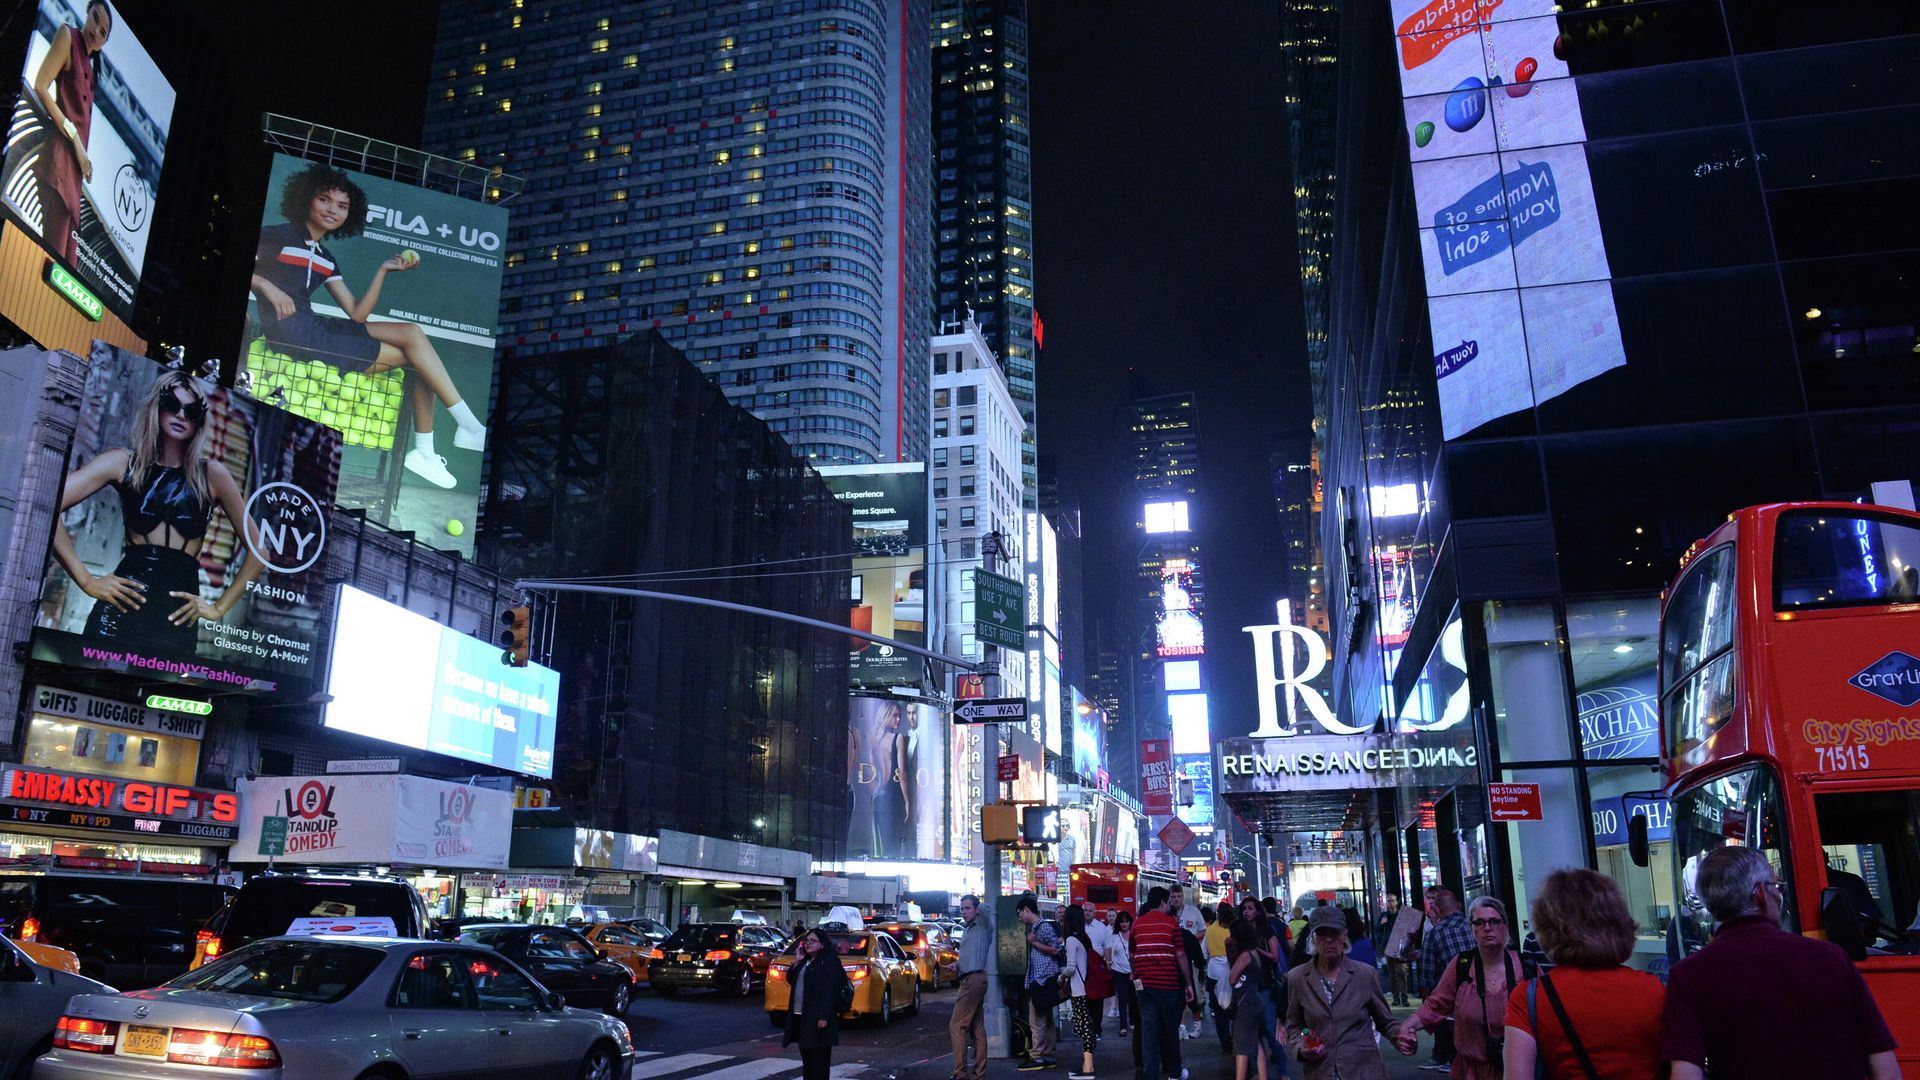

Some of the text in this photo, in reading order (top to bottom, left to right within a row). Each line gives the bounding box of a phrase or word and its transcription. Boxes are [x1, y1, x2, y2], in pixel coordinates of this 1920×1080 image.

[118, 187, 142, 225] NY
[365, 204, 430, 236] FILA
[459, 225, 500, 251] UO
[72, 230, 94, 257] Clothing
[111, 226, 135, 254] FASHION
[363, 231, 498, 268] INTRODUCING AN EXCLUSIVE COLLECTION FROM FILA
[57, 272, 99, 314] LAMAR
[389, 309, 490, 335] AVAILABLE ONLY AT URBAN OUTFITTERS
[265, 491, 311, 516] MADE
[845, 490, 884, 499] Experience
[280, 508, 296, 521] IN
[852, 507, 897, 516] imes Square.
[258, 518, 315, 560] NY
[245, 580, 306, 604] FASHION
[977, 573, 1022, 598] SOUTHBOUND
[981, 588, 995, 604] USE
[1005, 597, 1018, 610] AVE
[204, 620, 311, 652] Clothing by Chromat
[979, 623, 1021, 645] BEST ROUTE
[213, 636, 309, 665] Glasses by A-Morir
[1157, 646, 1205, 656] TOSHIBA
[1242, 624, 1375, 738] R
[1858, 672, 1904, 687] Gray
[39, 690, 203, 736] GIFTS LUGGAGE T-SHIRT
[152, 696, 207, 714] LAMAR
[963, 704, 1021, 717] ONE WAY
[1141, 760, 1170, 779] JERSEY
[1223, 748, 1394, 776] RENAISSANCE
[1814, 744, 1870, 771] 71515
[971, 735, 981, 832] PALACE
[1147, 777, 1169, 790] BOYS
[1490, 787, 1532, 795] NO STANDING
[12, 770, 238, 823] EMBASSY GIFTS
[285, 780, 335, 819] LOL
[1492, 796, 1518, 804] Anytime
[30, 811, 49, 822] NY
[70, 813, 111, 827] NY PD
[288, 820, 338, 833] TANDUP
[181, 824, 230, 838] LUGGAGE
[287, 832, 336, 852] OMEDY
